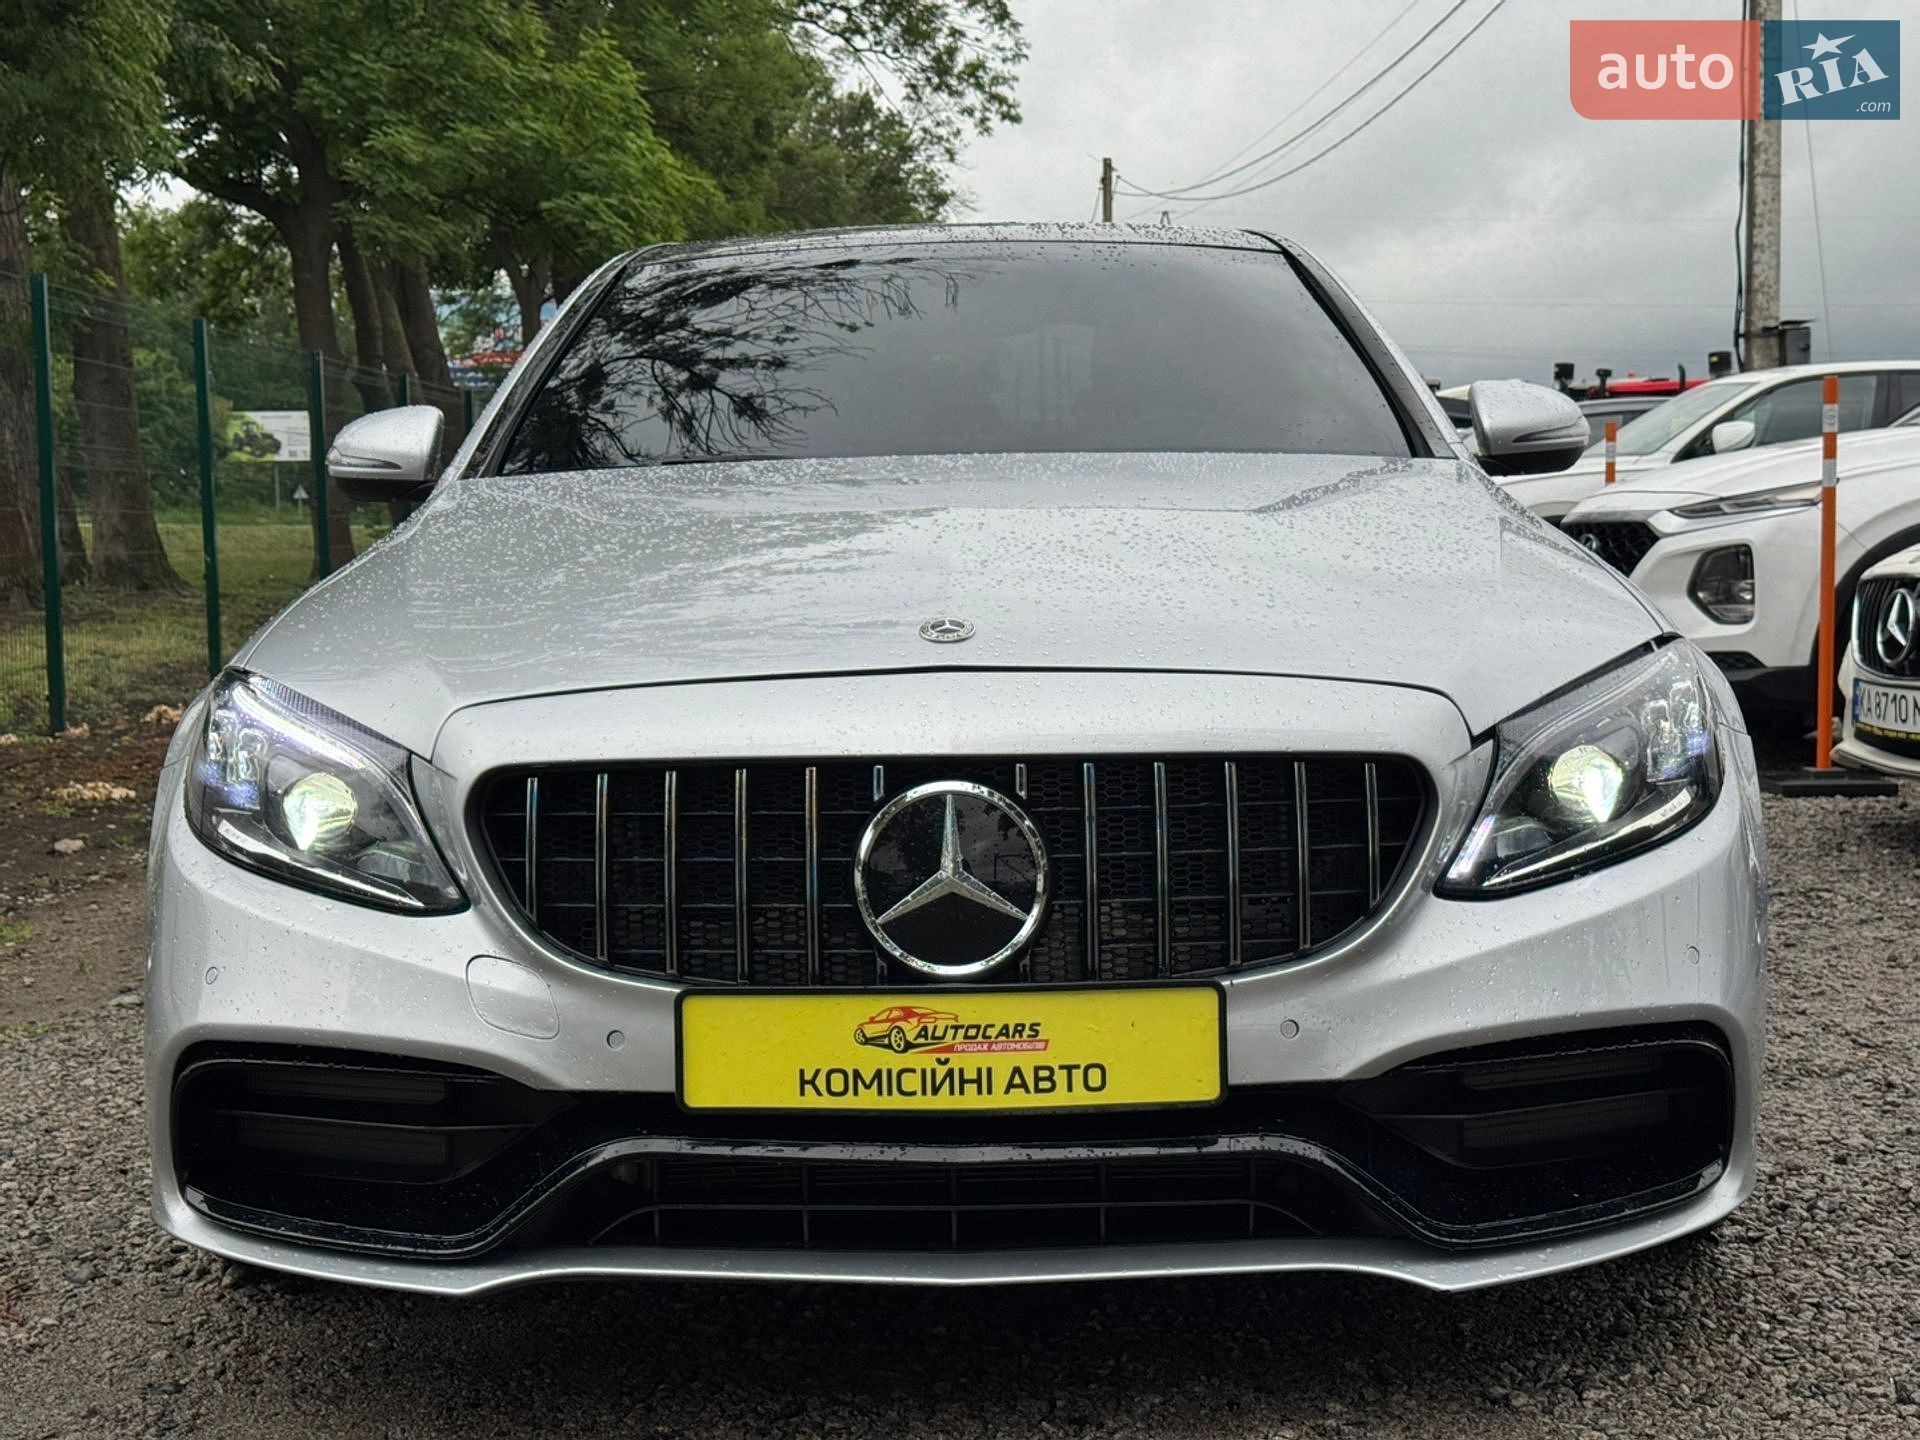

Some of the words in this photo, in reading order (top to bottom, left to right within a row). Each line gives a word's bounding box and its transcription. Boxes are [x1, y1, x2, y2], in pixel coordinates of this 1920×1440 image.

[913, 1022, 1042, 1041] AUTOCARS
[799, 1057, 992, 1098] КОМІСІЙНІ
[1003, 1063, 1107, 1096] АВТО
